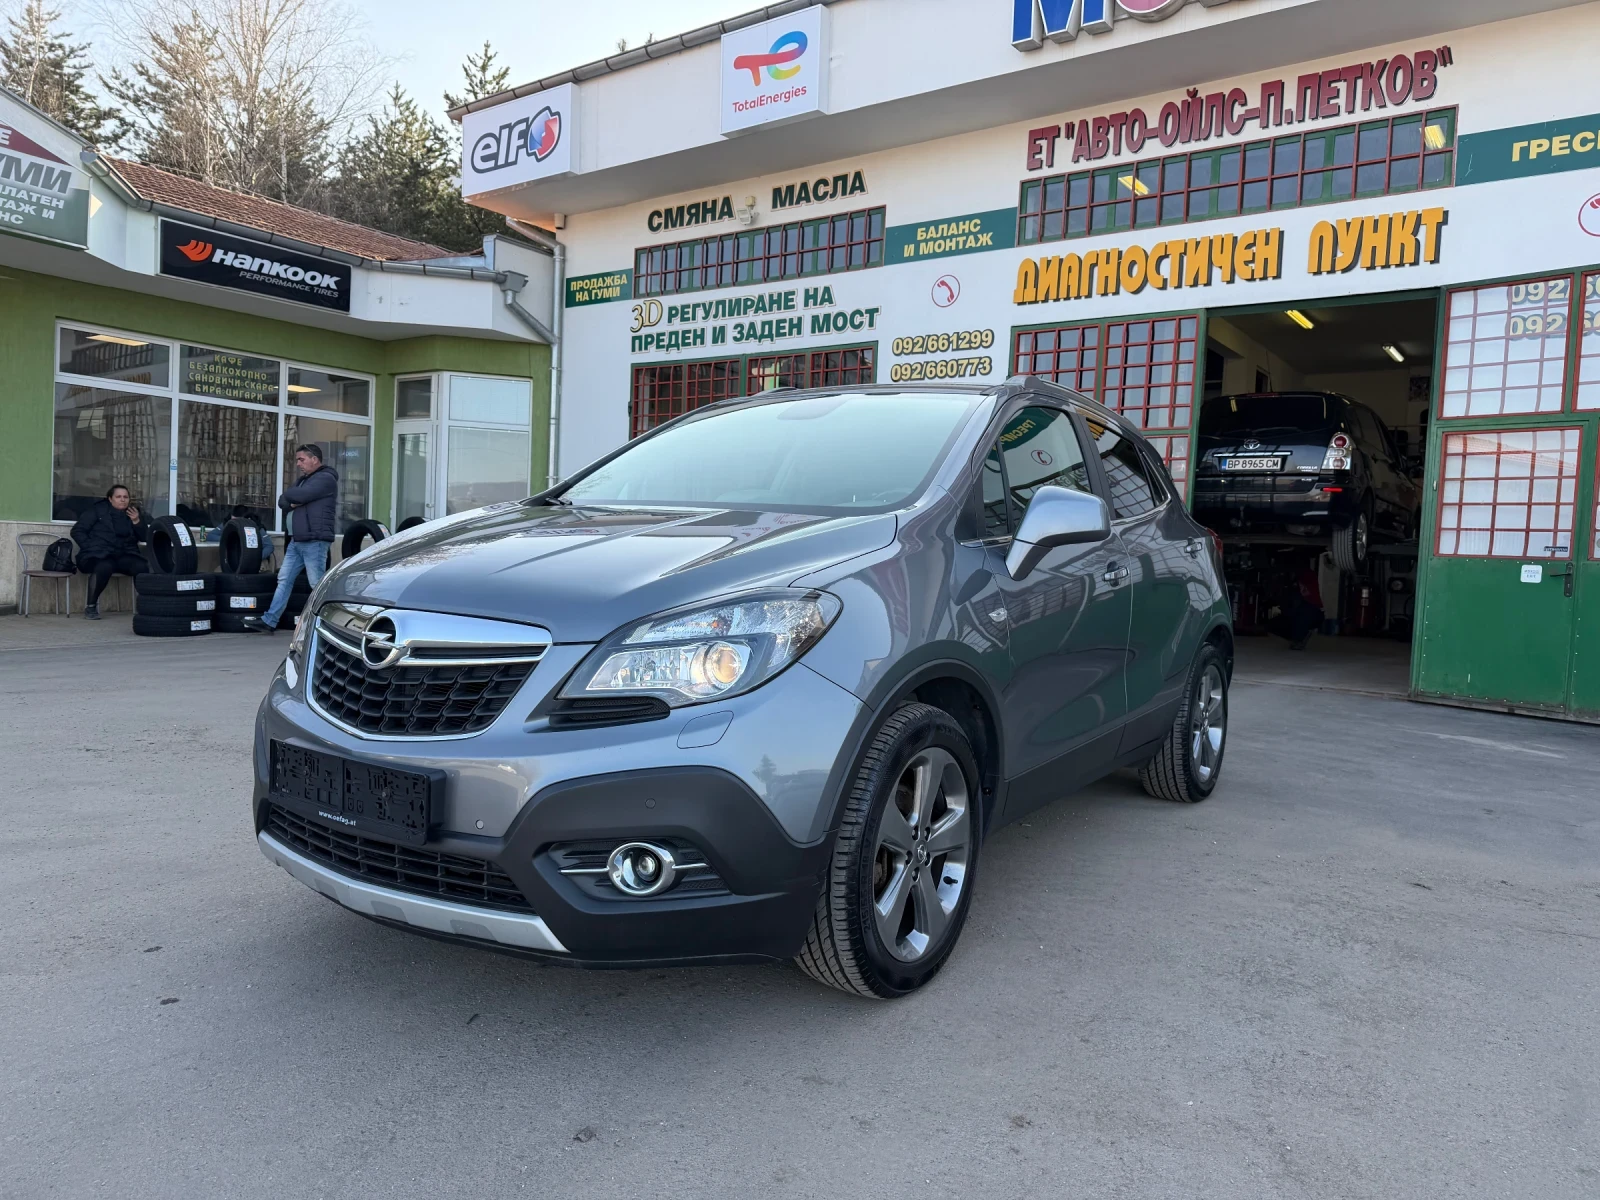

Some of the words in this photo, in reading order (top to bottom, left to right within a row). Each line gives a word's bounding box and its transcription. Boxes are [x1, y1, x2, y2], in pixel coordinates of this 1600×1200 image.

[732, 85, 807, 113] TotalEnergies
[471, 116, 531, 174] elf
[1026, 124, 1061, 171] ЕТ
[1511, 130, 1600, 162] ГРЕС
[0, 152, 72, 194] МИ
[0, 184, 65, 209] ЛАТЕН
[0, 197, 37, 215] АЖ
[41, 208, 56, 220] И
[647, 194, 736, 233] СМЯНА
[770, 168, 868, 211] МАСЛА
[916, 218, 982, 240] БАЛАНС
[903, 243, 915, 257] И
[918, 232, 993, 255] МОНТАЖ
[1013, 227, 1283, 305] ДИАГНОСТИЧЕН
[1307, 207, 1447, 275] ПУНКТ
[239, 270, 311, 292] PERFORMANCE
[313, 286, 339, 298] TIRES
[570, 274, 628, 291] ПРОДАЖБА
[575, 292, 589, 302] НА
[591, 286, 621, 300] ГУМИ
[630, 299, 663, 332] 3D
[667, 291, 796, 324] РЕГУЛИРАНЕ
[803, 285, 834, 307] НА
[631, 328, 705, 352] ПРЕДЕН
[711, 325, 726, 345] И
[732, 316, 803, 343] ЗАДЕН
[810, 306, 880, 334] МОСТ
[892, 329, 994, 356] 092/661299
[214, 354, 242, 366] КАФЕ
[890, 356, 992, 382] 092/660773
[1241, 459, 1265, 468] 8965
